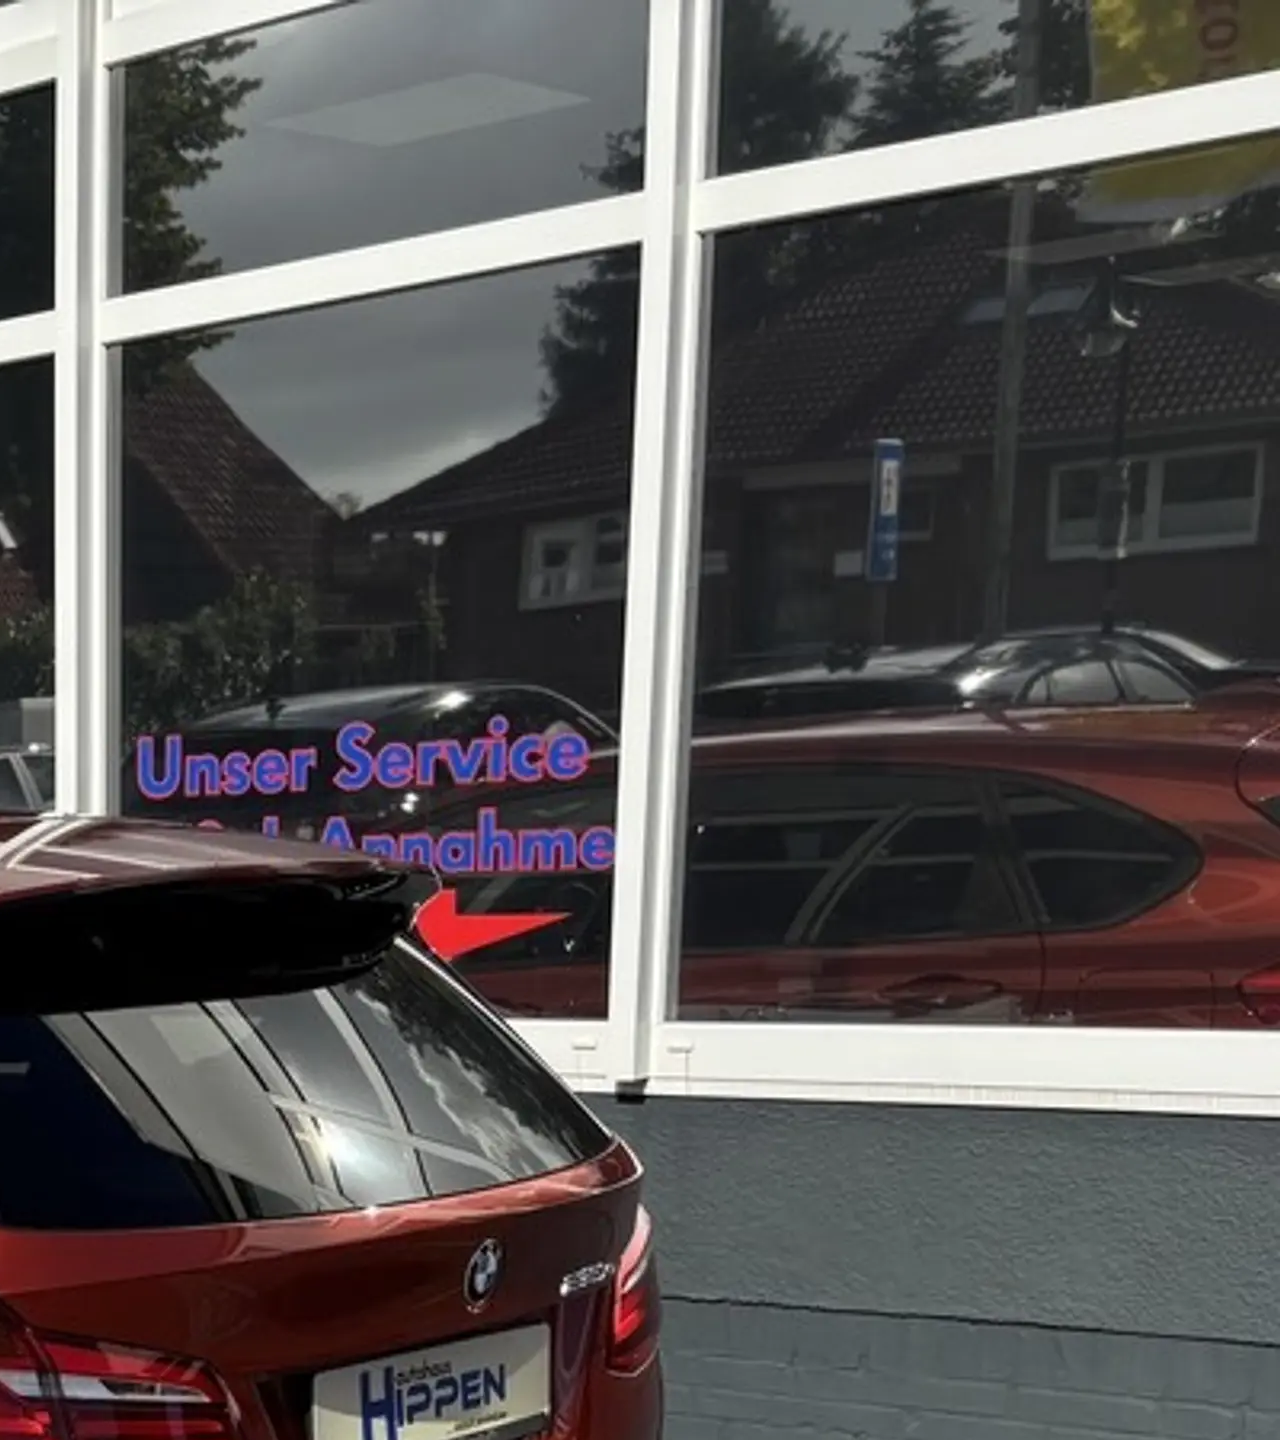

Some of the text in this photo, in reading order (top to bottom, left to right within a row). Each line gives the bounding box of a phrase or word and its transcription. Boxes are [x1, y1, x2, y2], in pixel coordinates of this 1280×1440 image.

[137, 714, 591, 799] Unser Service
[320, 807, 616, 874] Annahme
